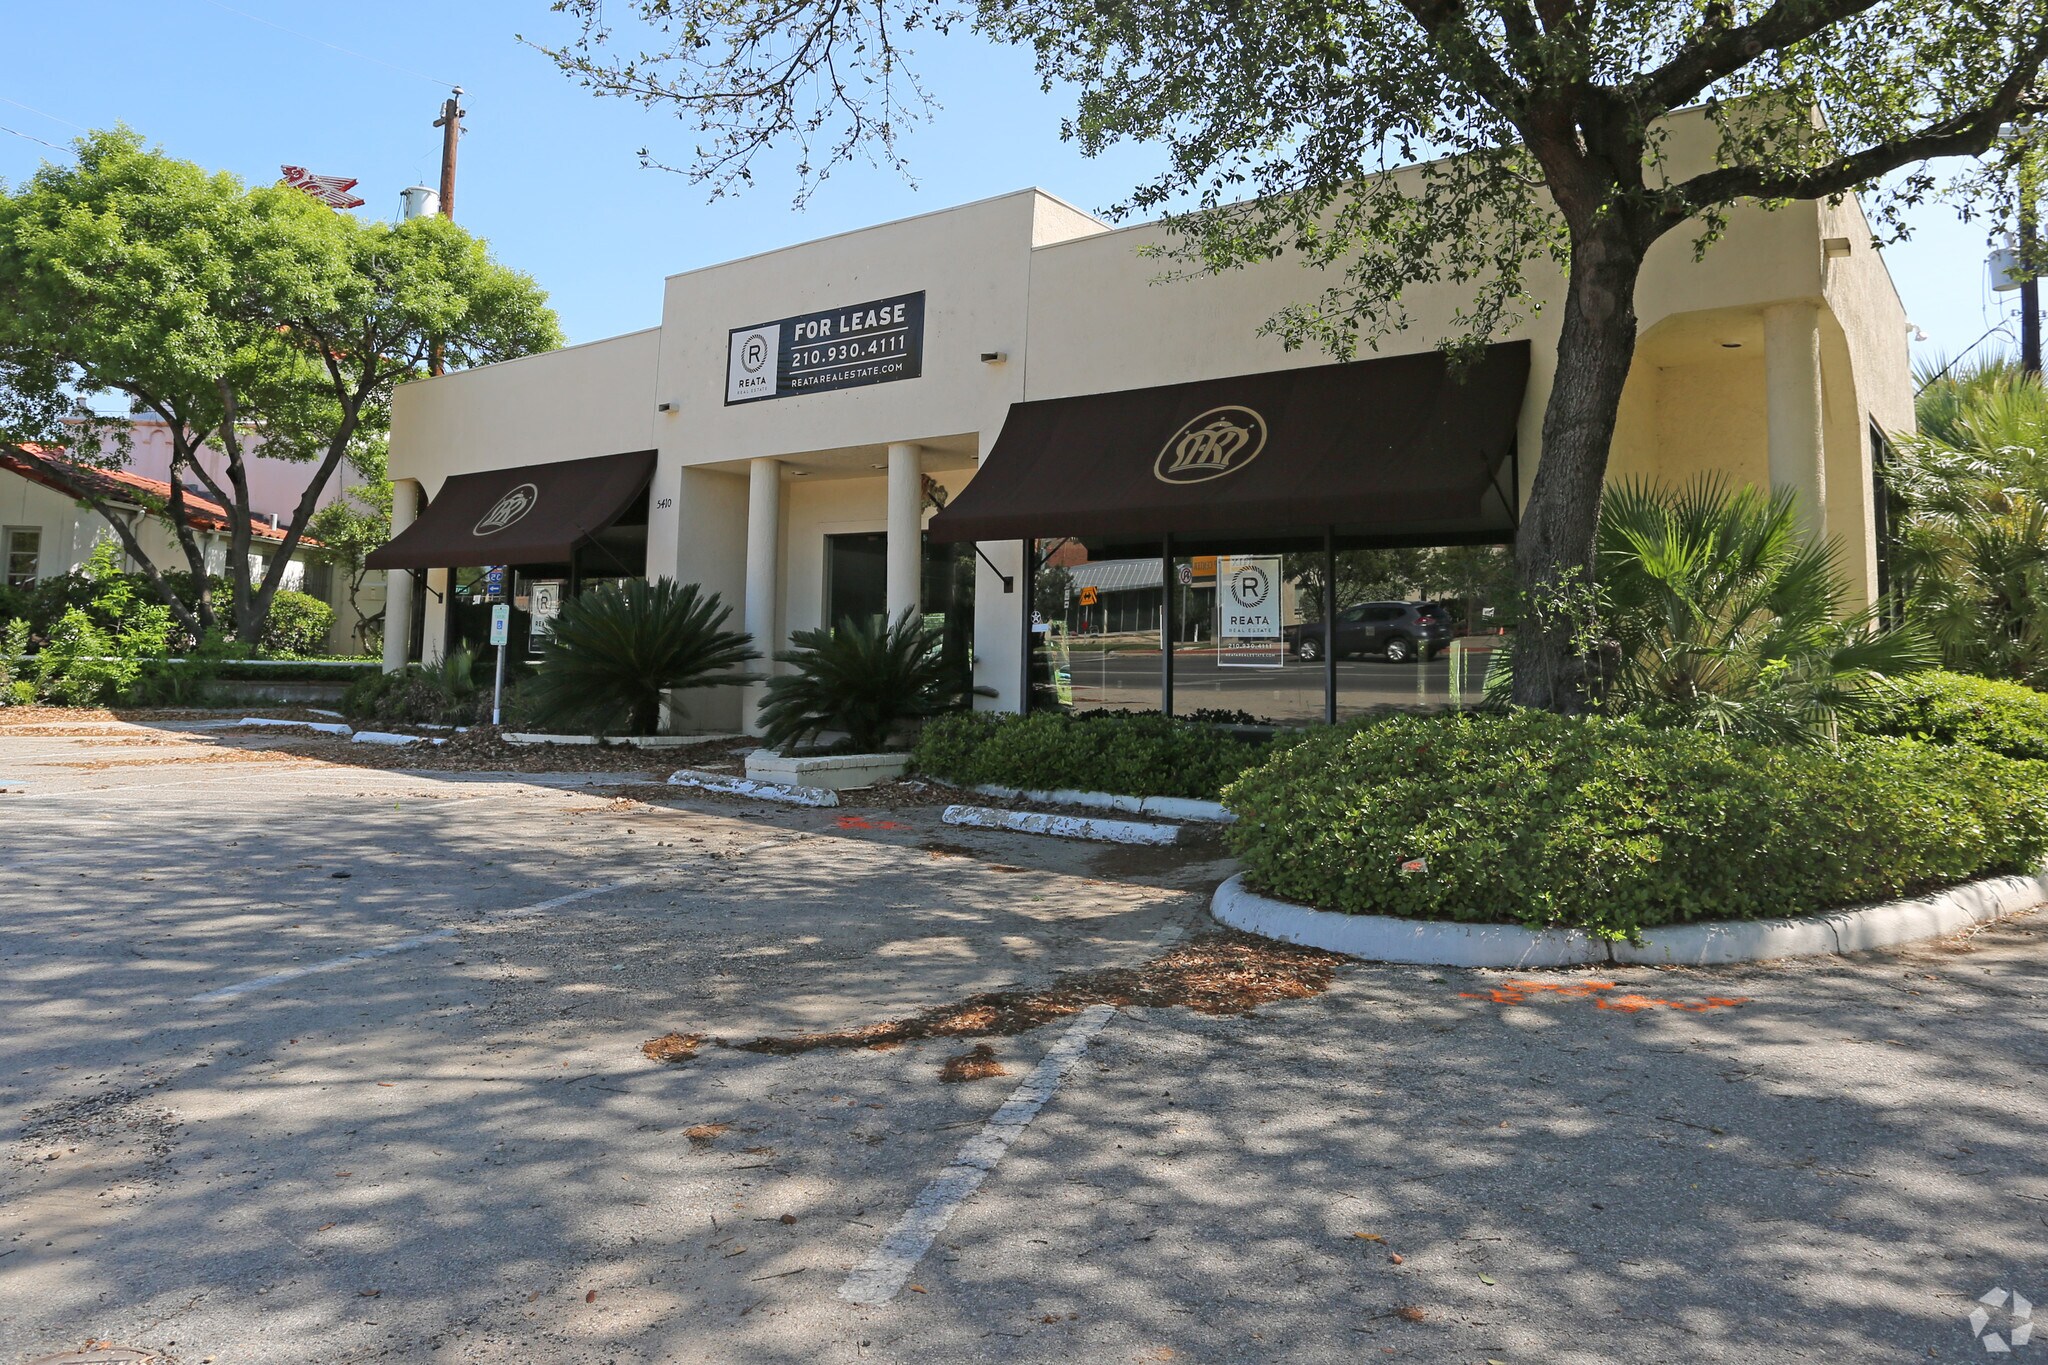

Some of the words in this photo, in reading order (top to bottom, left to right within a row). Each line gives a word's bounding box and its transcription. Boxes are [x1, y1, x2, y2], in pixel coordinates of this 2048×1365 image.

[794, 318, 831, 341] FOR
[839, 303, 906, 333] LEASE
[748, 344, 761, 364] R
[791, 334, 905, 367] 210.930.4111
[738, 376, 767, 388] REATA
[791, 363, 903, 388] REATAREALESTATE.COM
[656, 498, 672, 510] 5410
[1242, 577, 1259, 598] R
[1230, 616, 1270, 625] REATA
